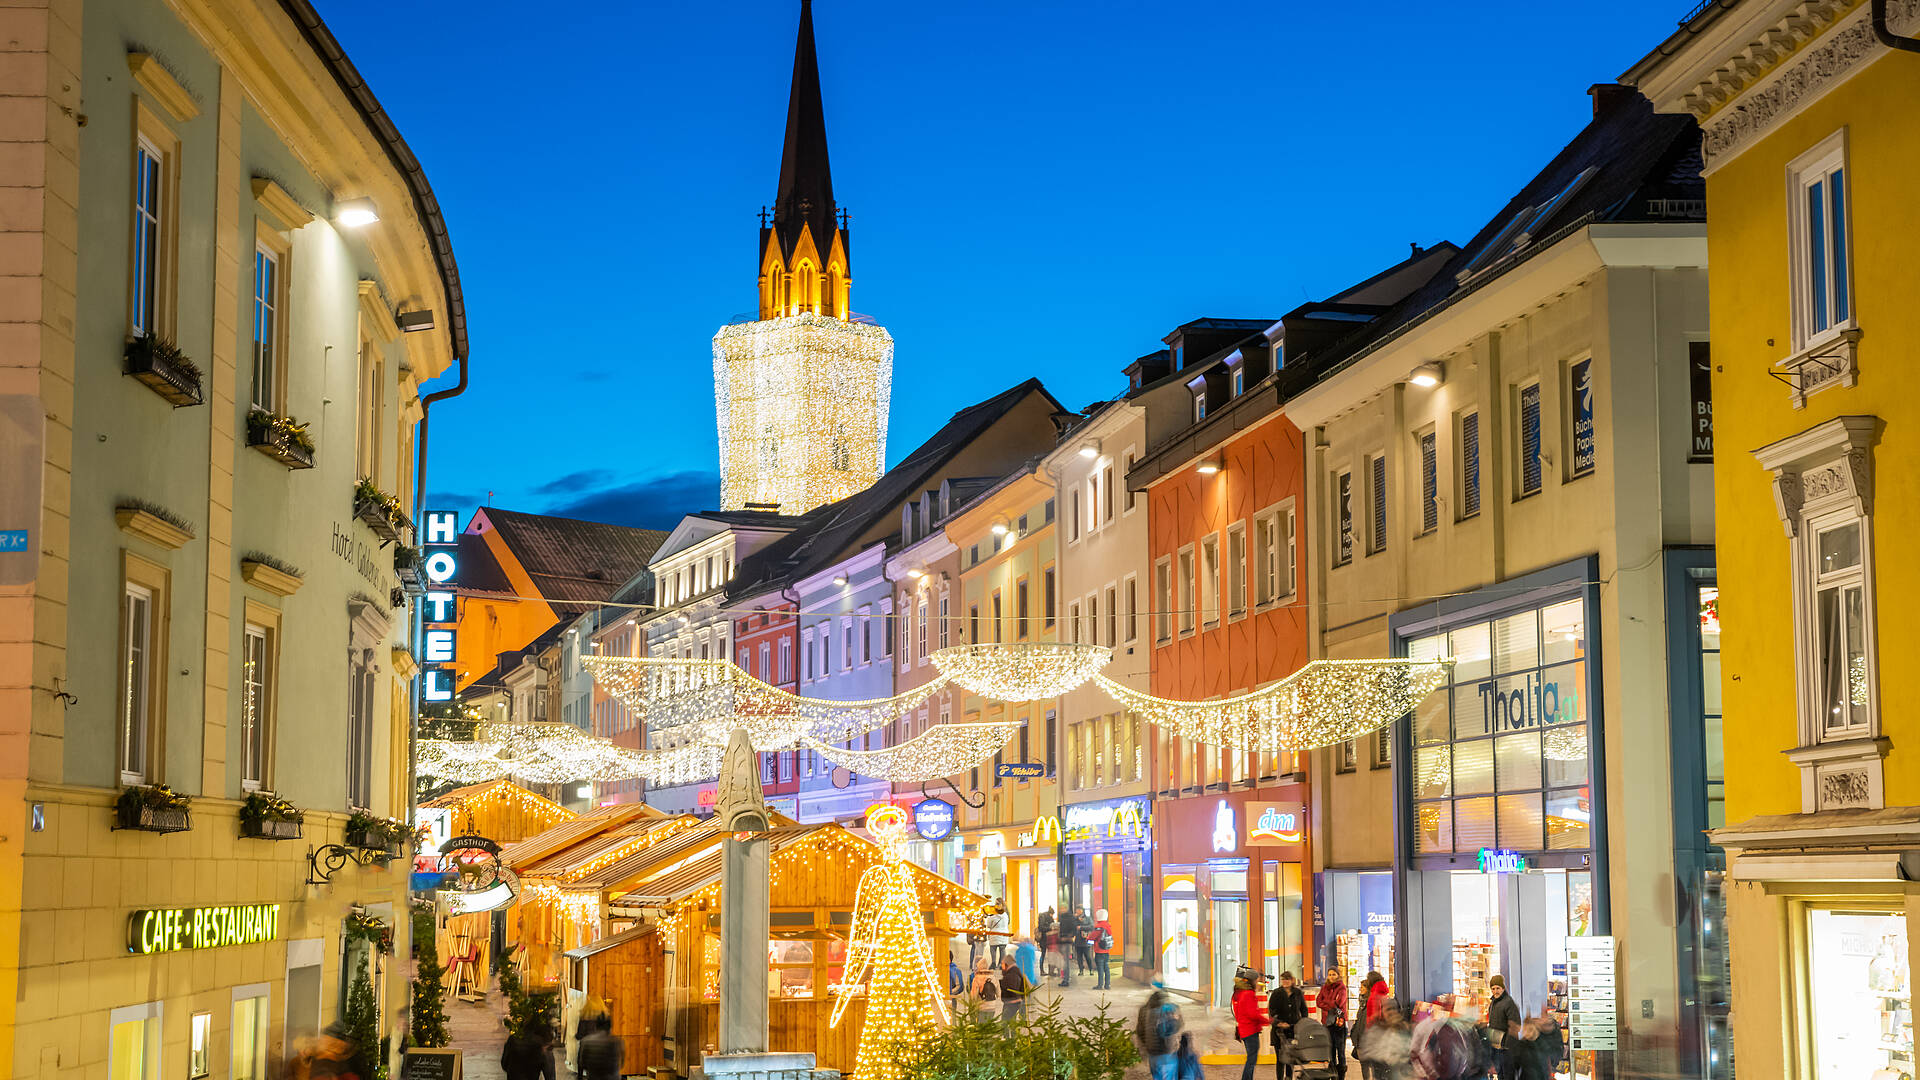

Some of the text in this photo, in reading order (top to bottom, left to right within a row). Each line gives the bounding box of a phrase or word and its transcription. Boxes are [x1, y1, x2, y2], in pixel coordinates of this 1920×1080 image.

[332, 521, 355, 565] Hotel
[426, 513, 457, 700] HOTEL
[1258, 808, 1295, 831] dm
[452, 838, 489, 848] GASTHOF
[141, 904, 280, 955] CAFE RESTAURANT
[1367, 911, 1394, 923] Zum
